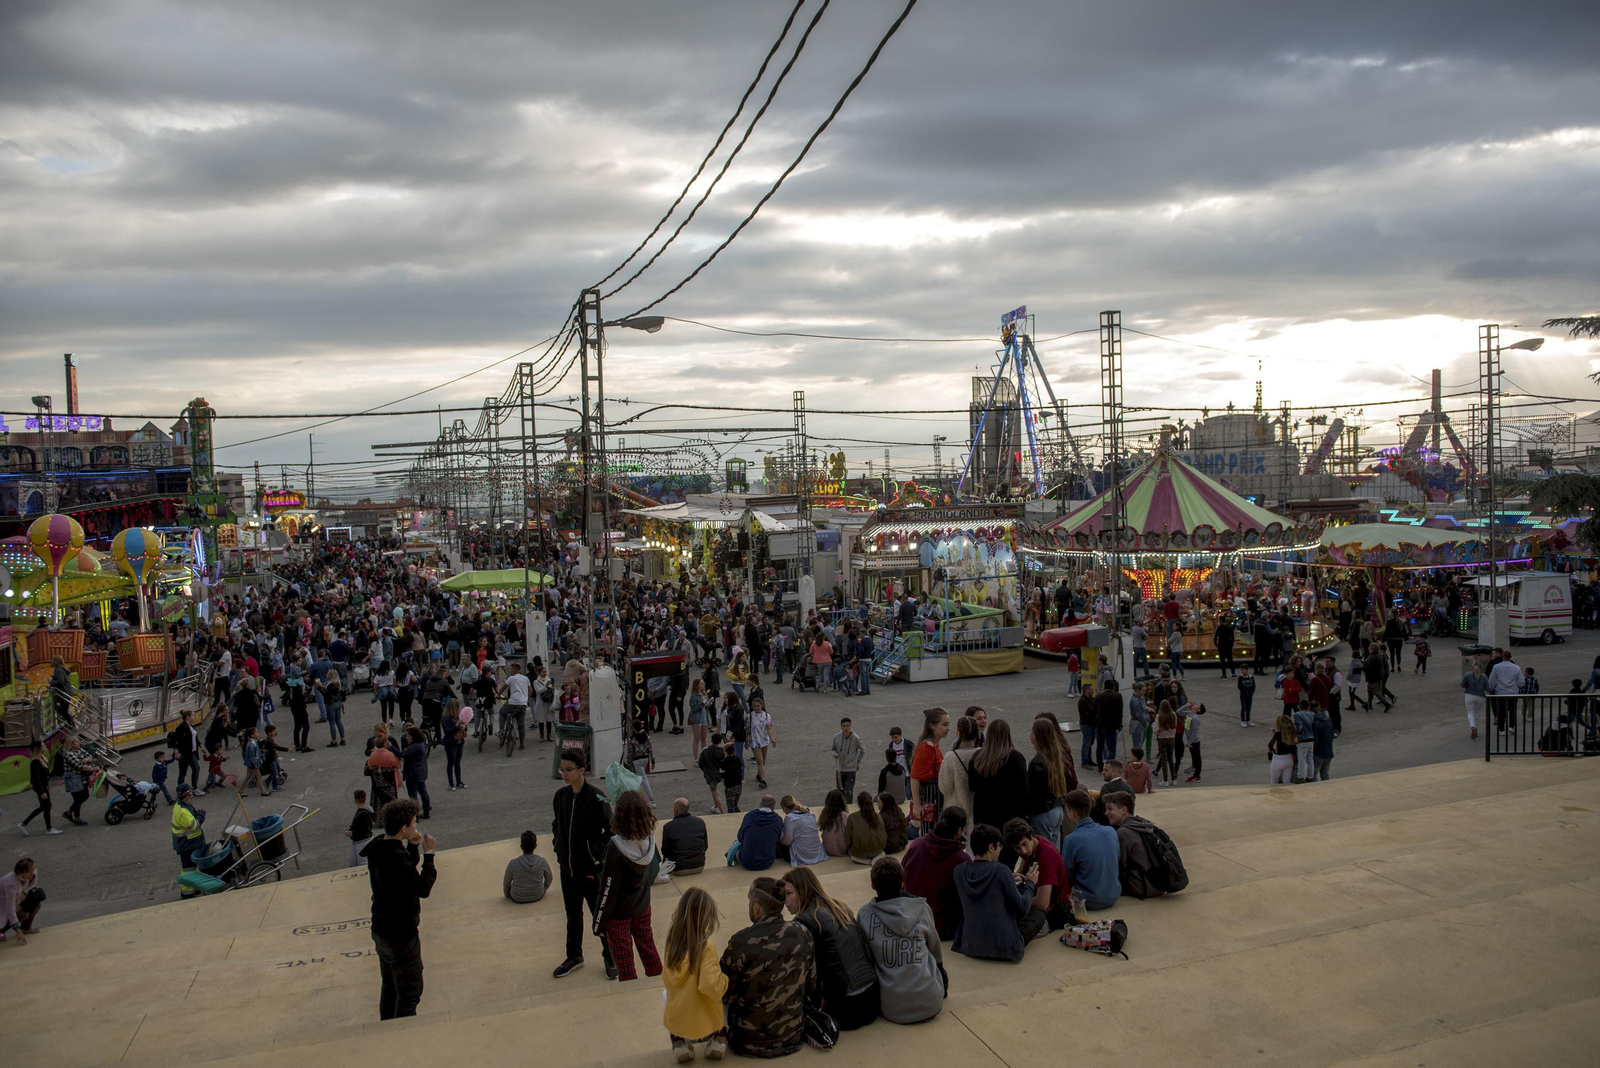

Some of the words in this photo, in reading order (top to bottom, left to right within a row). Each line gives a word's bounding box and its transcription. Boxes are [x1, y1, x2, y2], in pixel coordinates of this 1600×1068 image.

[1001, 305, 1026, 327] SUPER
[25, 414, 102, 430] MIEDO
[1229, 453, 1266, 474] PRIX
[914, 508, 991, 520] PREMIOLANDIA
[600, 896, 608, 909] WALL
[882, 936, 922, 968] URE
